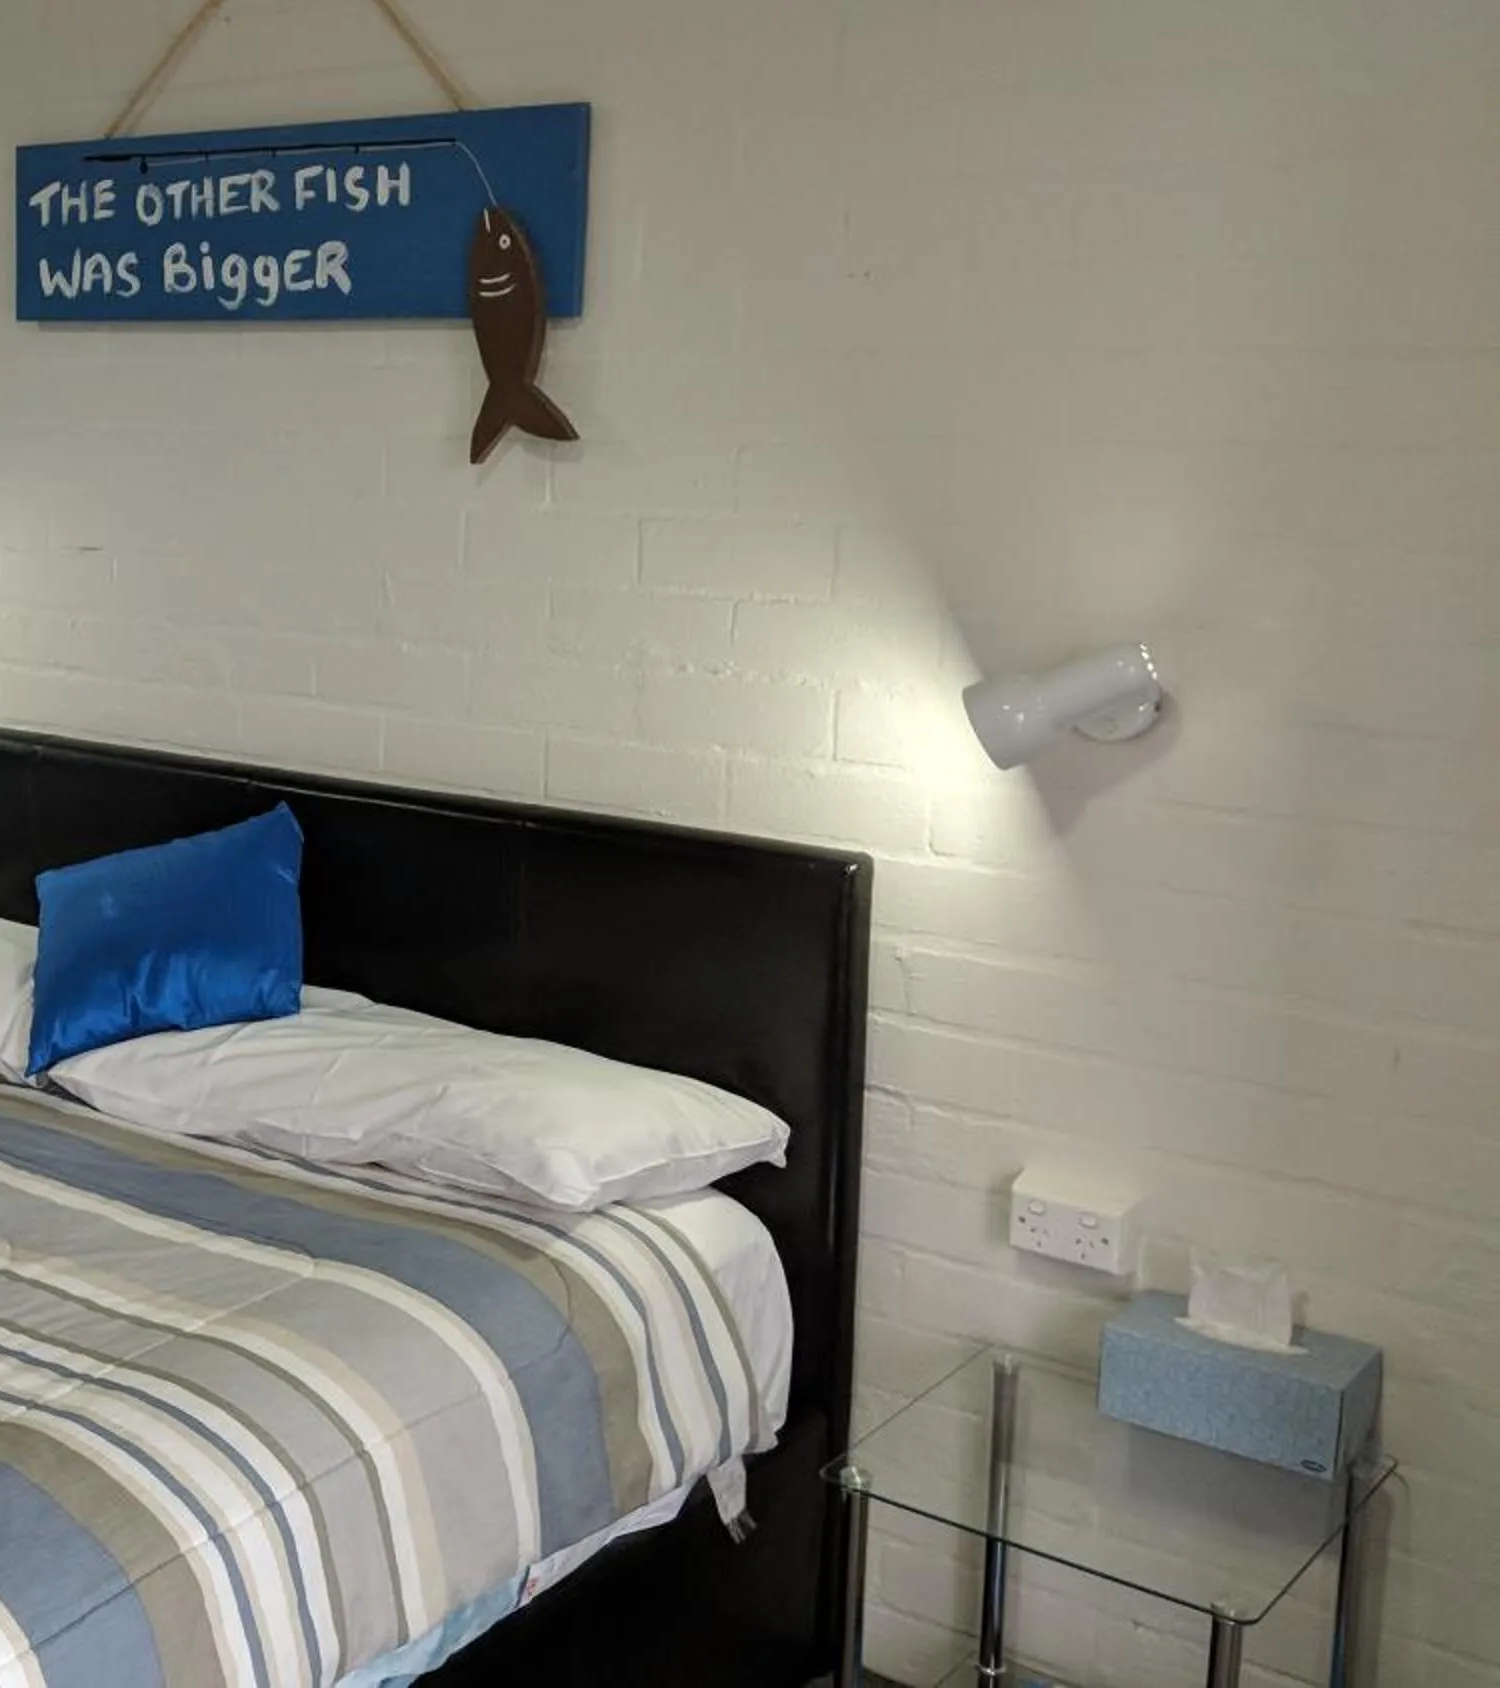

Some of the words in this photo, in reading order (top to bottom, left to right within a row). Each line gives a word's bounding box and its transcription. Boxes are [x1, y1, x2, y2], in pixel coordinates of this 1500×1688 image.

[29, 179, 116, 228] THE
[135, 170, 280, 227] OTHER
[295, 162, 411, 212] FISH
[39, 248, 141, 299] WAS
